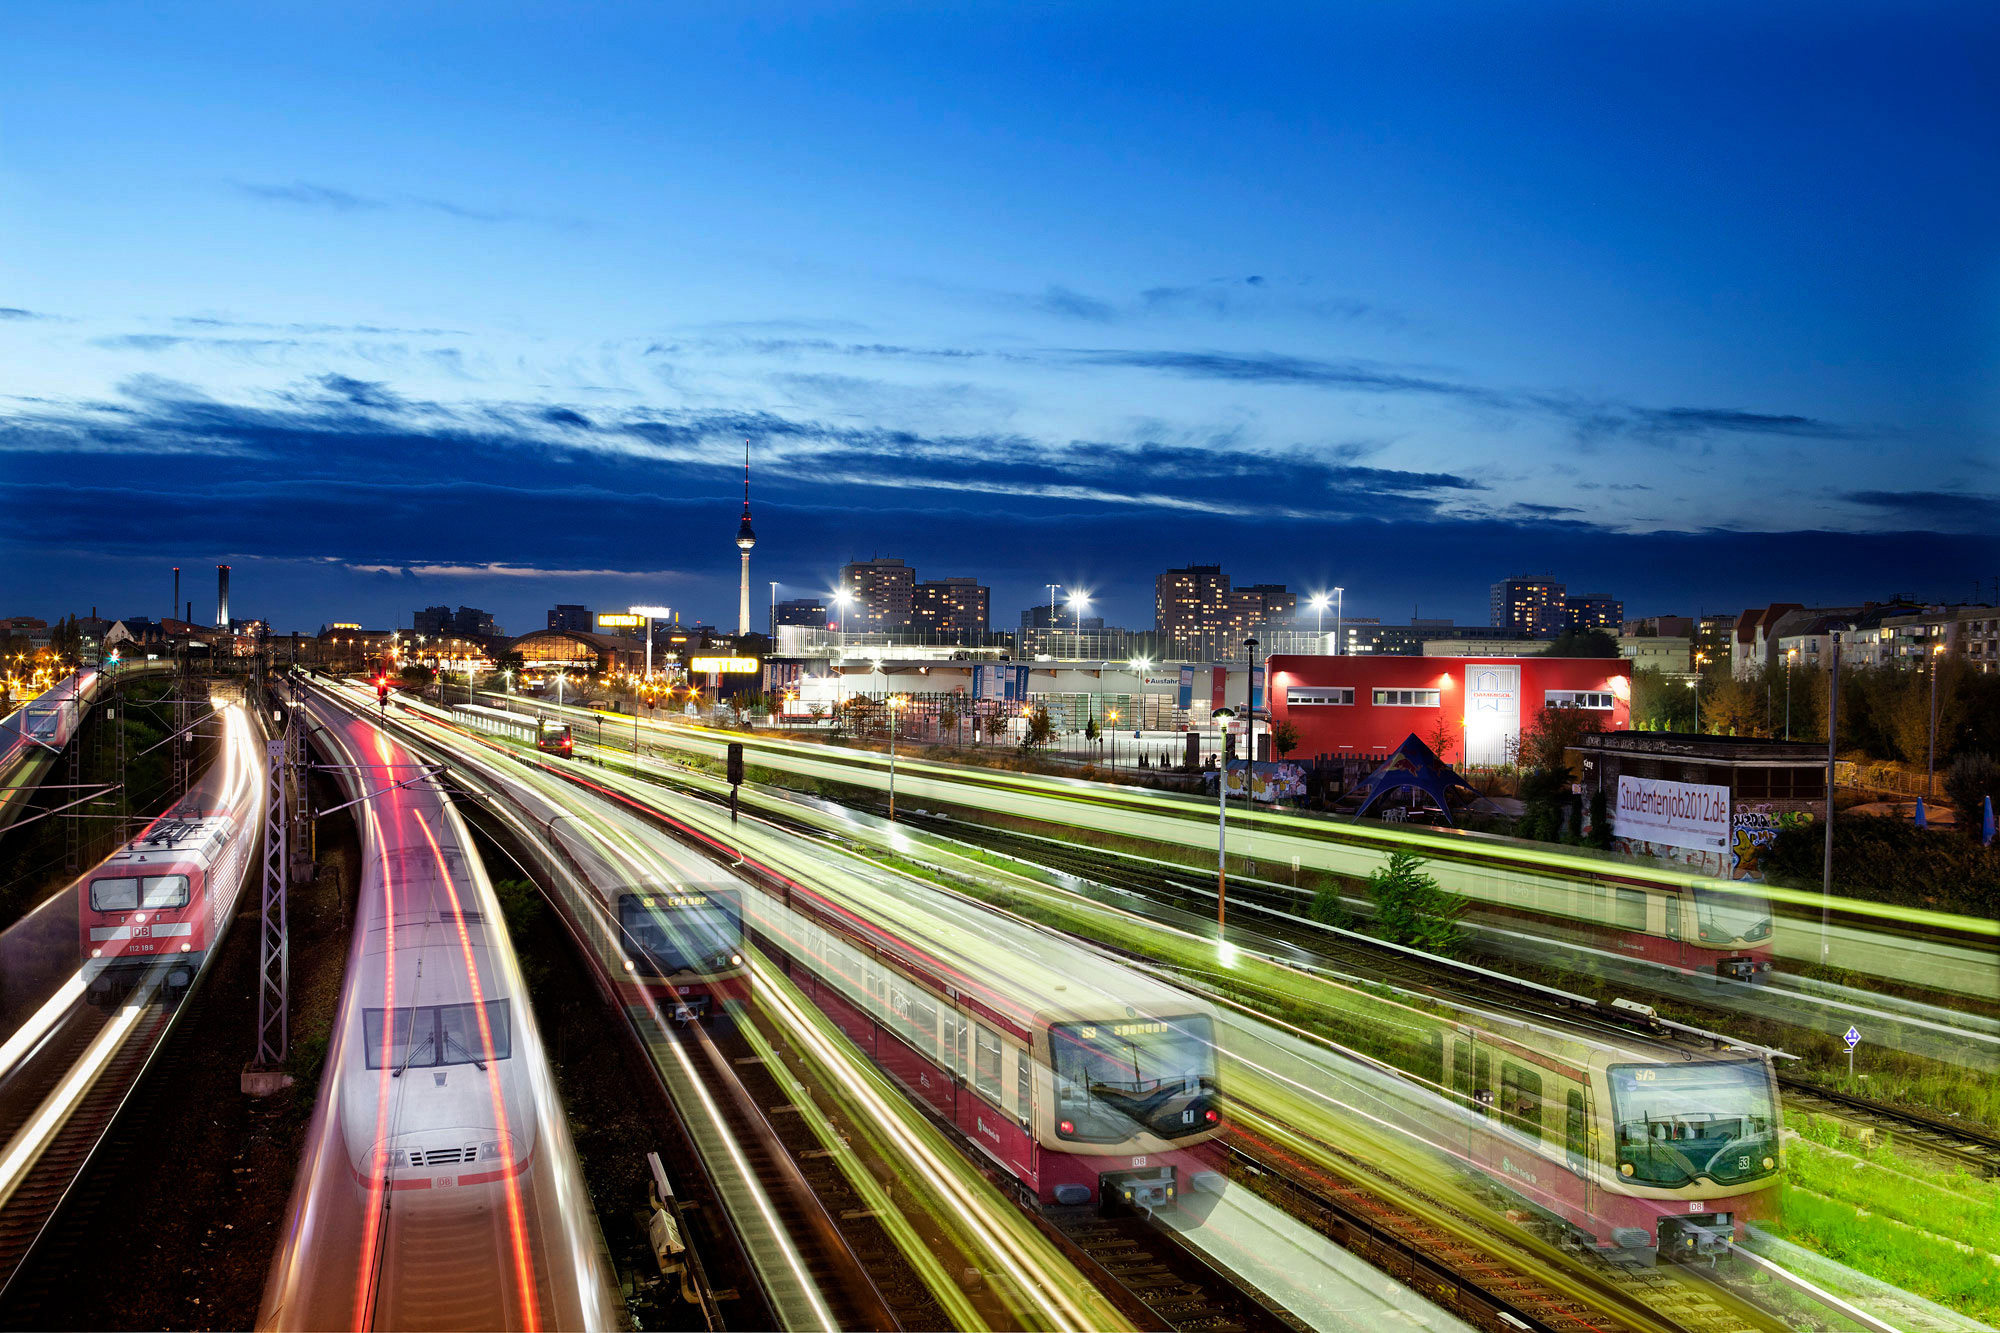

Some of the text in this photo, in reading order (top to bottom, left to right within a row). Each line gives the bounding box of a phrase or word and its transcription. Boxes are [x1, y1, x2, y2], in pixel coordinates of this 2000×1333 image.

[598, 614, 638, 627] METRO
[691, 657, 758, 673] METRO
[1621, 781, 1727, 824] Studentenjob2012.de
[668, 896, 707, 906] Erkner
[133, 927, 149, 937] DB
[1133, 1157, 1145, 1166] DB
[1739, 1157, 1749, 1168] 53
[439, 1178, 451, 1186] DB
[1690, 1202, 1703, 1212] DB
